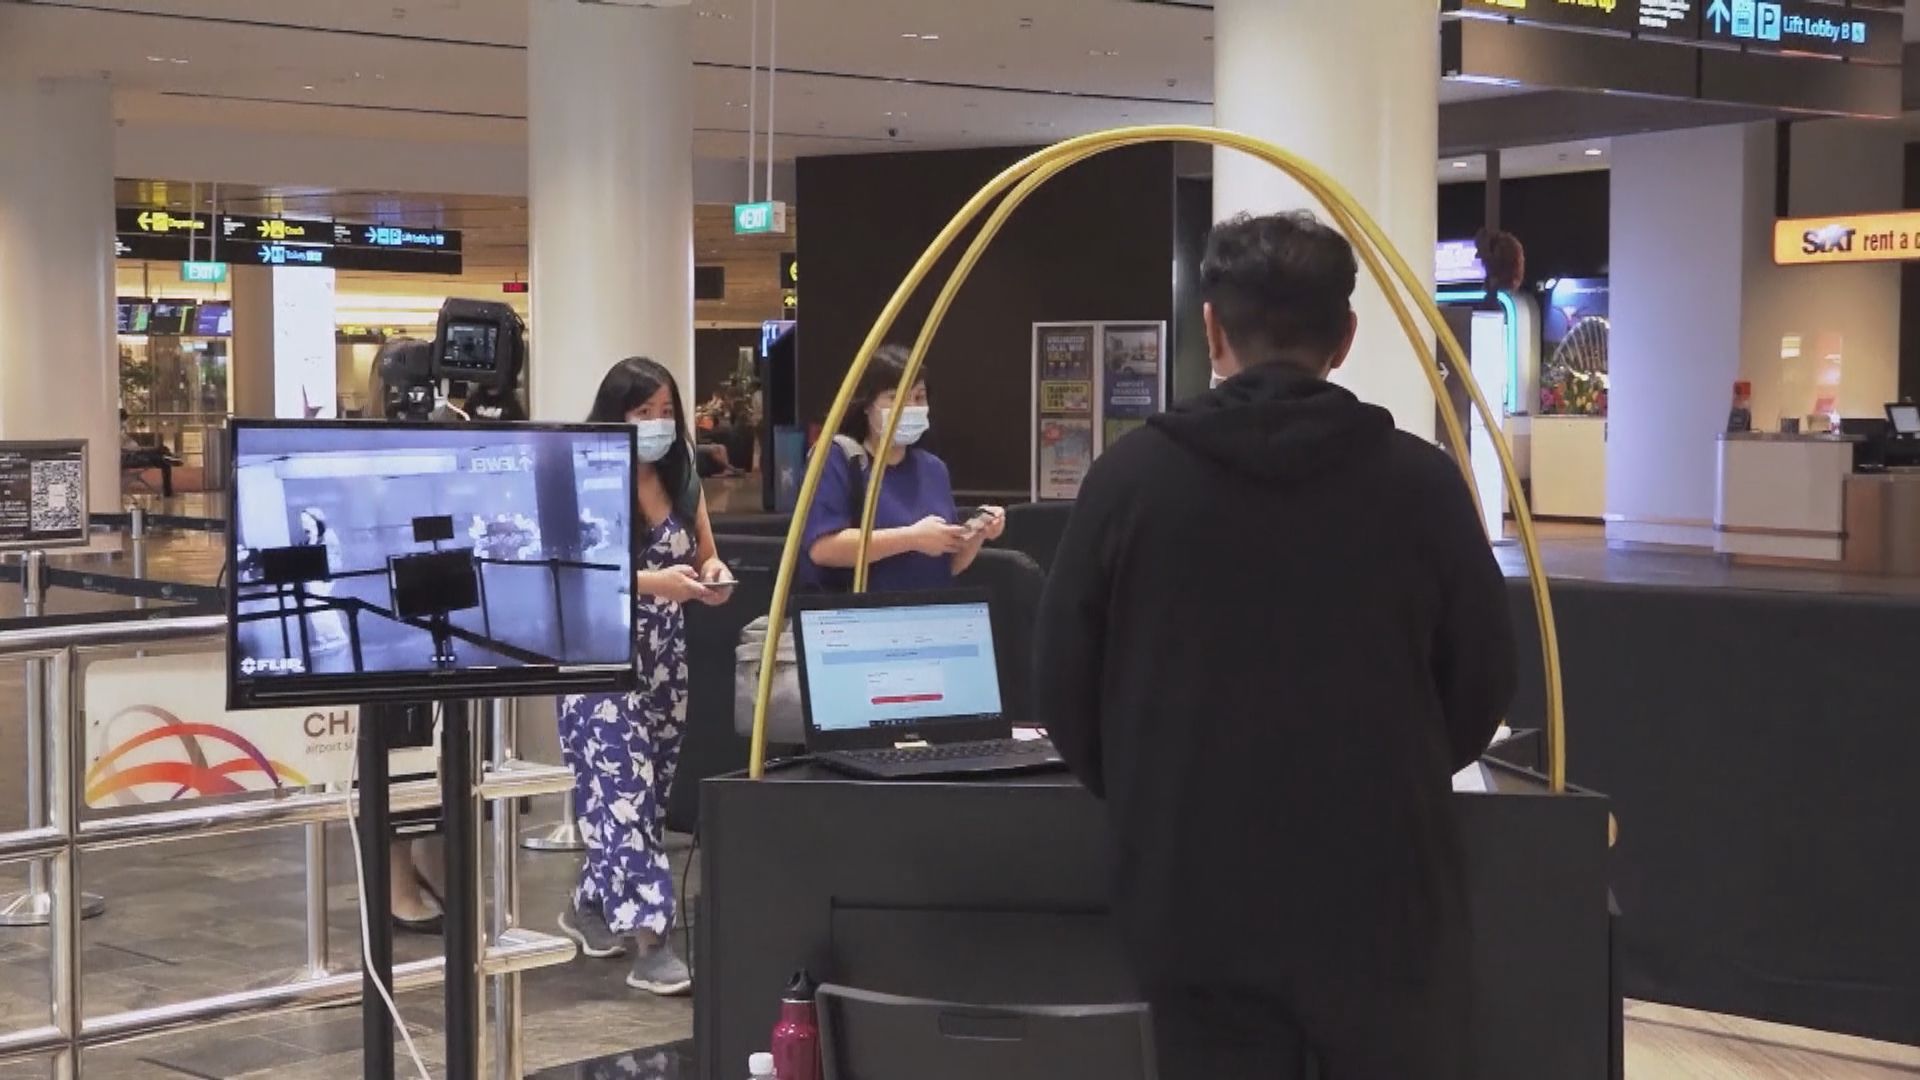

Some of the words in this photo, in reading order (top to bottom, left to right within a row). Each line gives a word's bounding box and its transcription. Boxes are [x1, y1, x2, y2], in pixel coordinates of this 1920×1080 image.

[1783, 15, 1804, 34] Lift
[1805, 18, 1841, 43] Lobby
[744, 207, 768, 229] EXIT
[1863, 230, 1894, 251] rent
[1900, 232, 1908, 249] a
[189, 265, 214, 280] EXIT
[256, 658, 306, 673] FLIR
[304, 711, 356, 737] CH
[305, 742, 342, 754] airport
